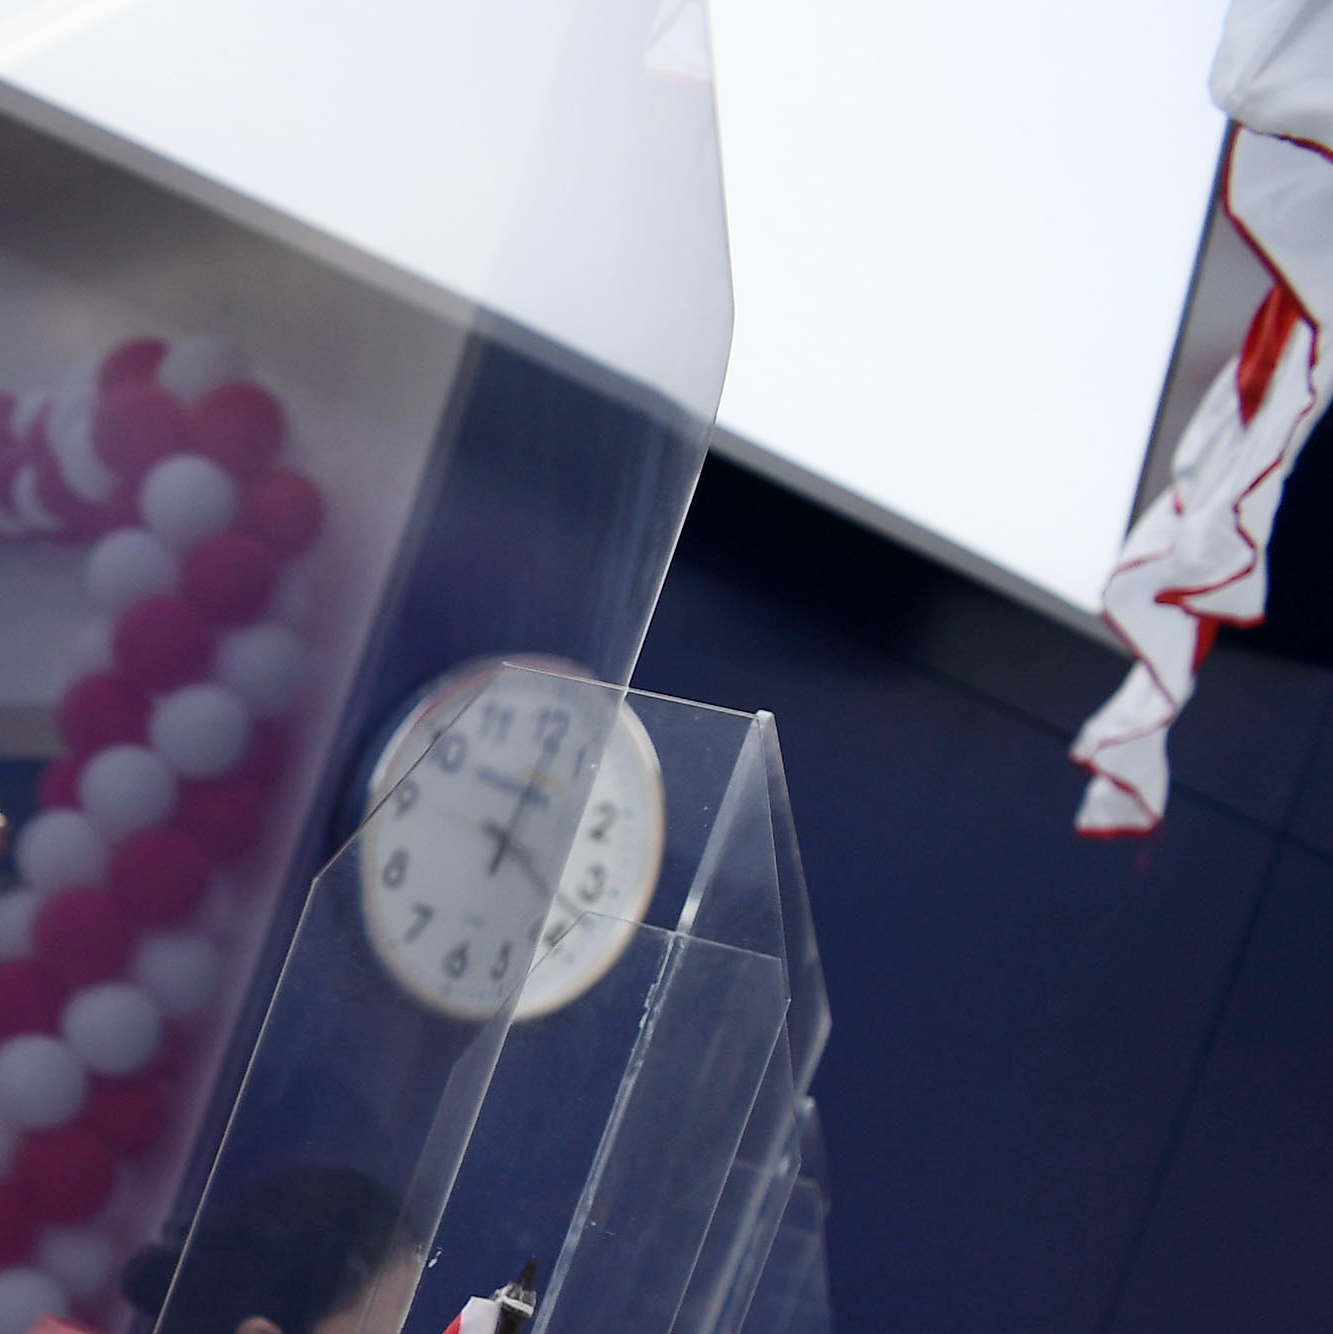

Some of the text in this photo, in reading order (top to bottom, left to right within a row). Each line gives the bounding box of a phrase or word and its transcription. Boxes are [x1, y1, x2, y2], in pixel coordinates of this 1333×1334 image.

[590, 804, 617, 841] 2
[403, 902, 434, 943] 7
[441, 940, 470, 981] 6
